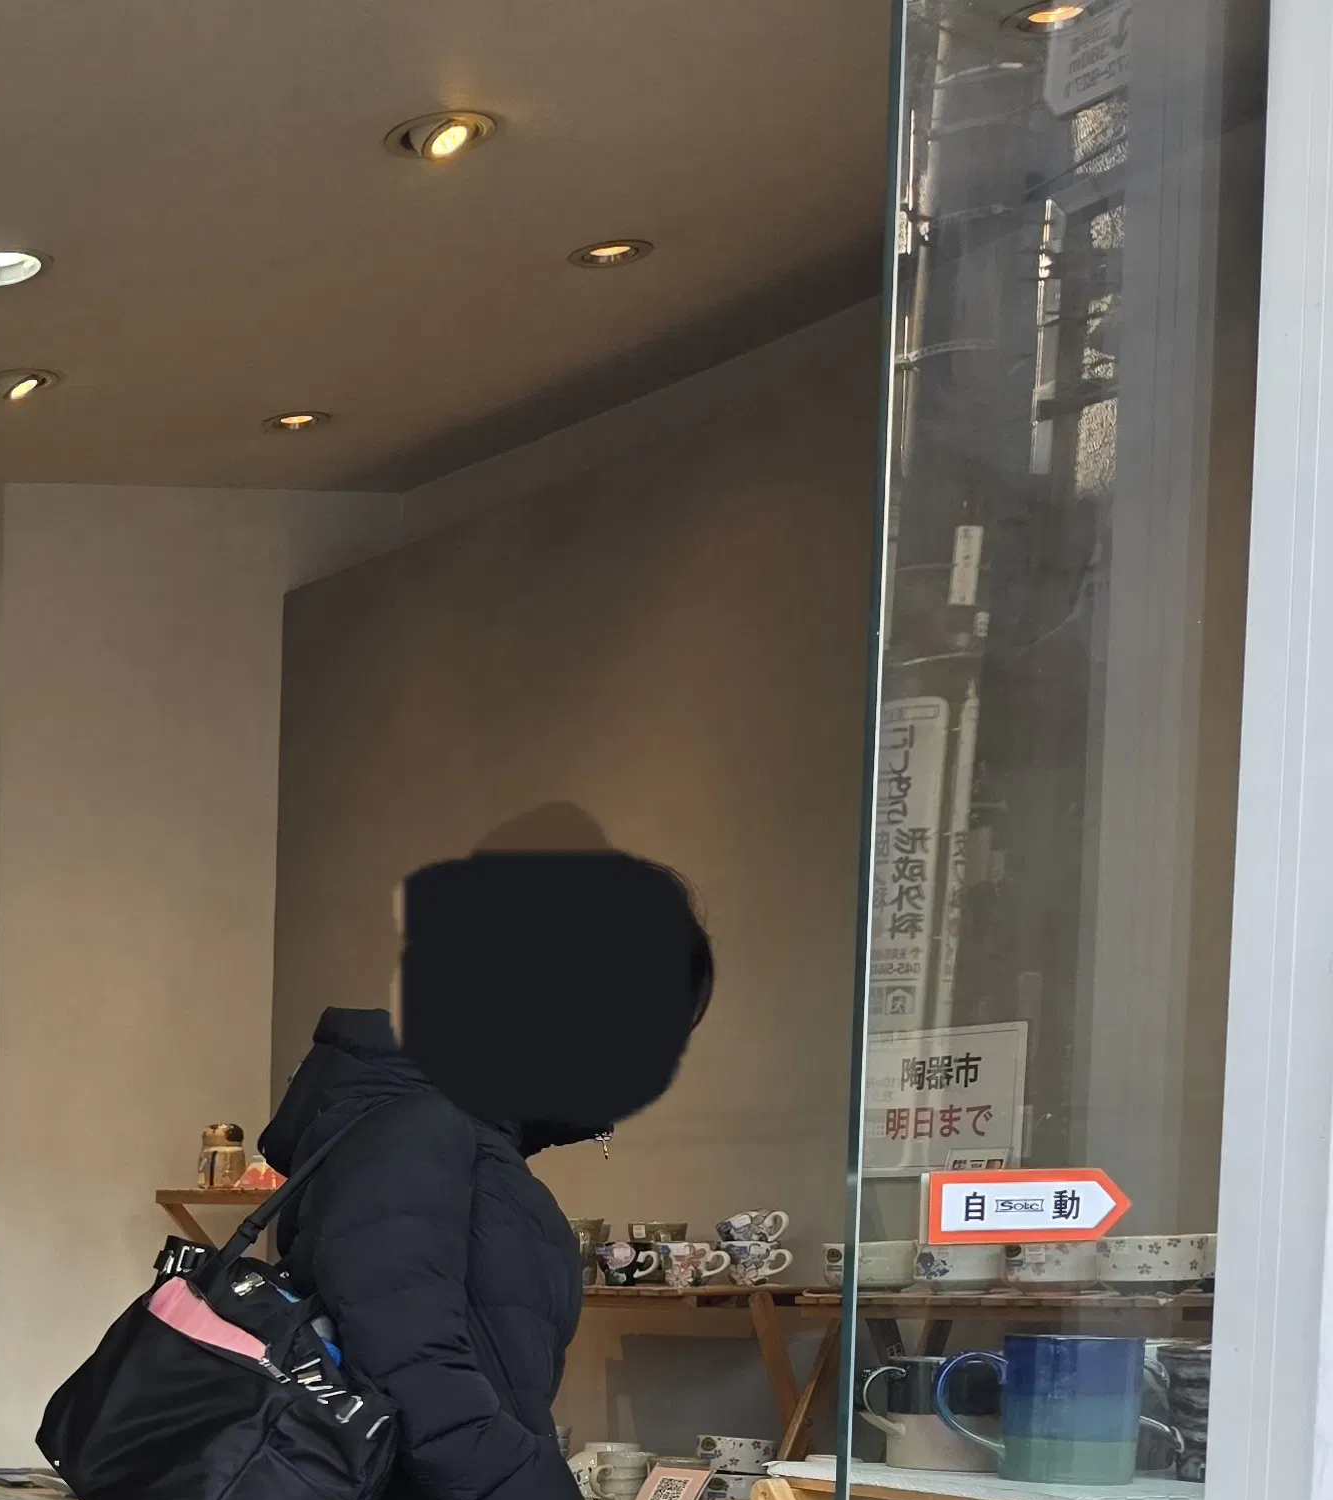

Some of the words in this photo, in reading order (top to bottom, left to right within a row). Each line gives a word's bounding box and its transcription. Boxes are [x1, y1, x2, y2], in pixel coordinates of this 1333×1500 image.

[900, 1052, 982, 1091] 陶器市
[885, 1104, 993, 1140] 明日まで
[964, 1192, 985, 1221] 自
[1051, 1189, 1081, 1220] 動
